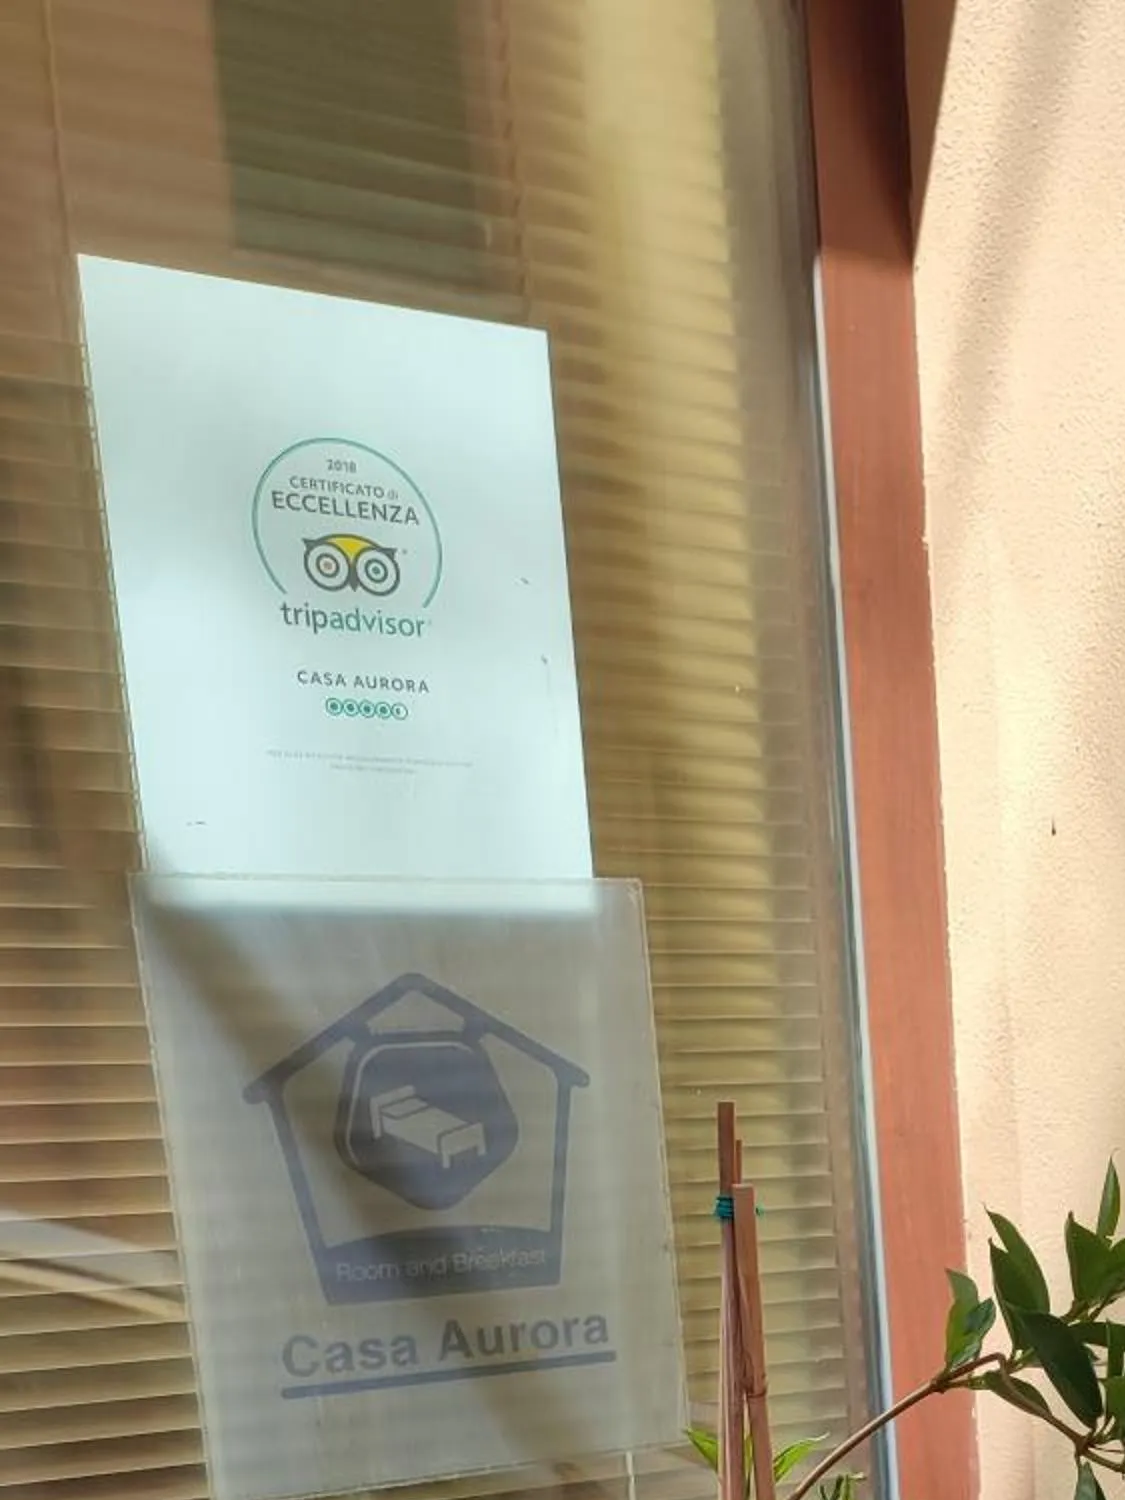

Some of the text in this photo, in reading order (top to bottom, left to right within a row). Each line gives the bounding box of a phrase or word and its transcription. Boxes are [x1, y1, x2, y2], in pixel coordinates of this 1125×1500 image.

[326, 459, 357, 474] 2018
[289, 475, 399, 501] CERTIFICATO di
[271, 490, 420, 526] ECCELLENZA
[280, 602, 425, 638] tripadvisor
[297, 669, 430, 694] CASA AURORA
[336, 1247, 546, 1283] Room and Breakfast
[281, 1312, 609, 1378] Casa Aurora
